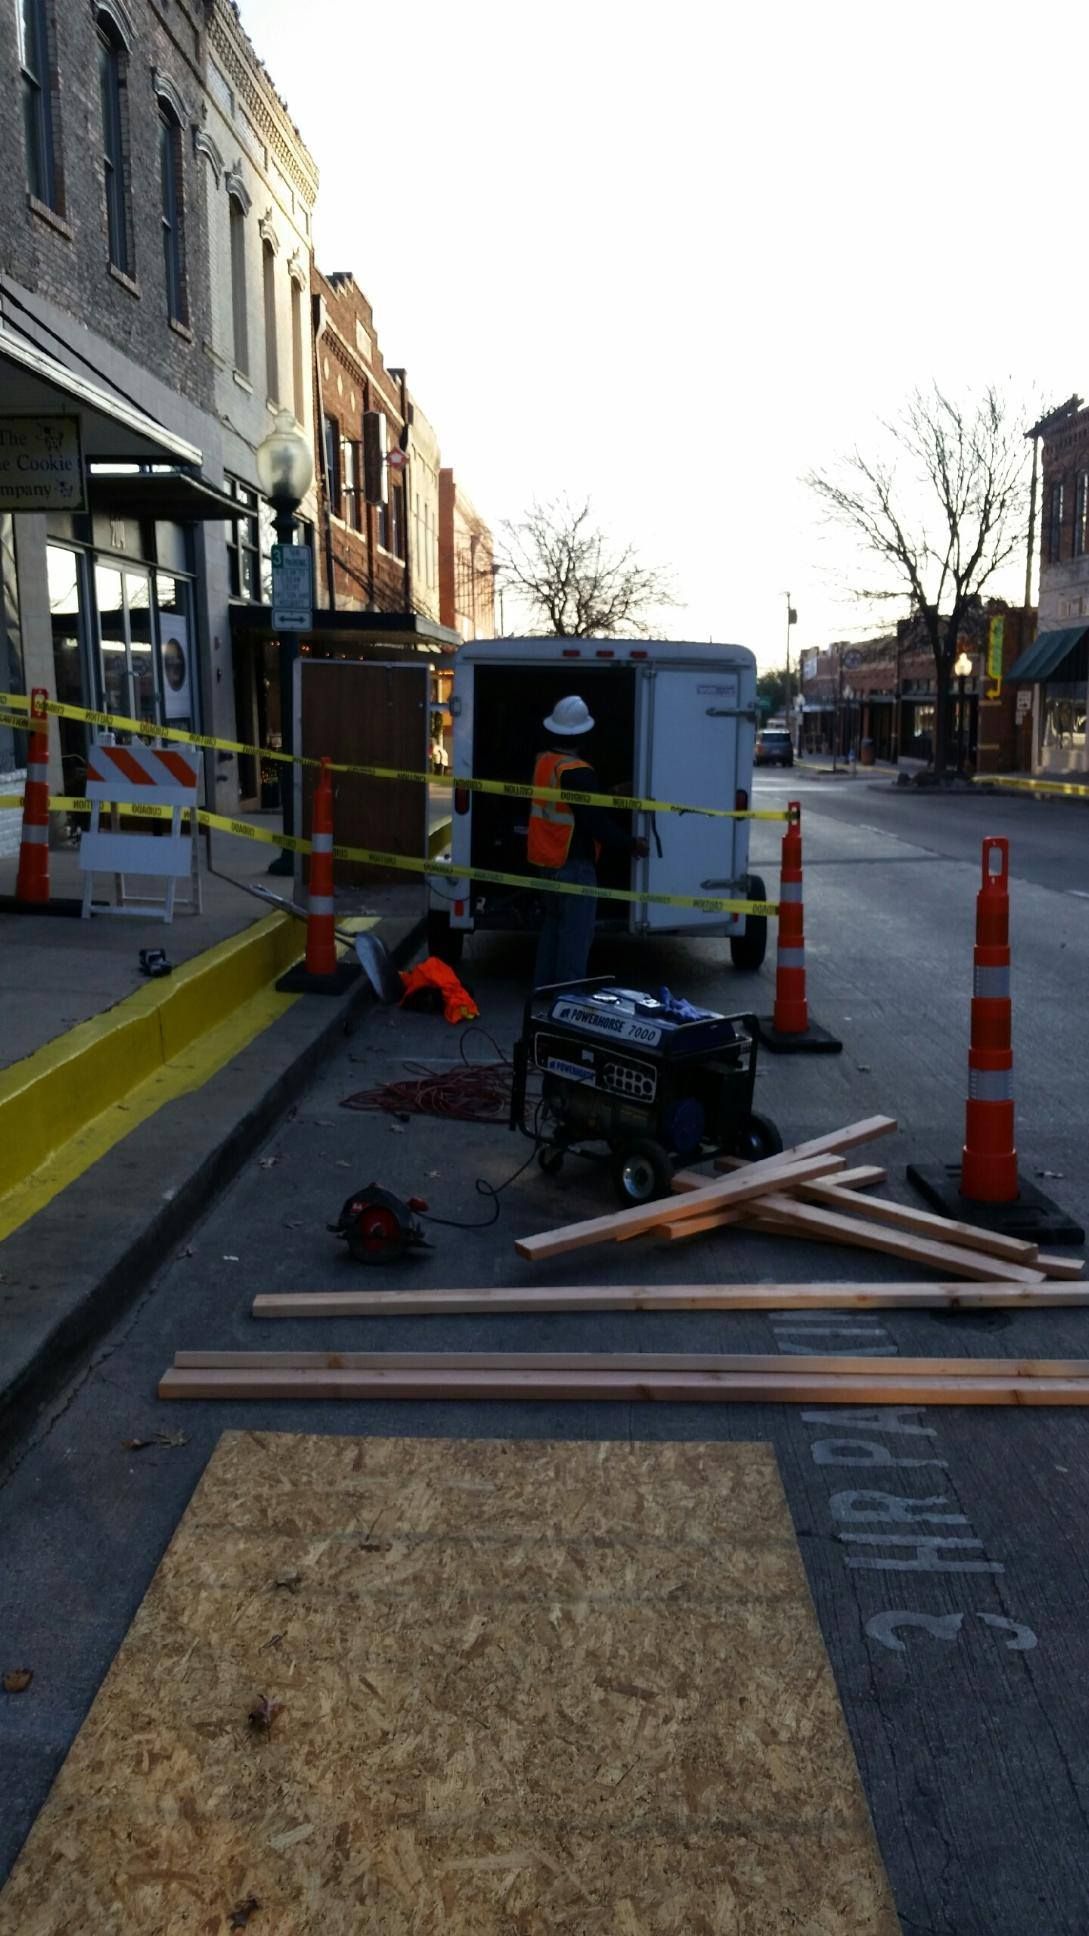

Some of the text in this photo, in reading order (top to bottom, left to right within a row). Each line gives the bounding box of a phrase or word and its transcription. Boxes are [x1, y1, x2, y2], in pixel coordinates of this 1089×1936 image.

[17, 454, 73, 471] Cookie
[273, 549, 283, 566] 3
[570, 1009, 656, 1042] POWERHORSE 7000
[828, 1489, 1006, 1573] HR
